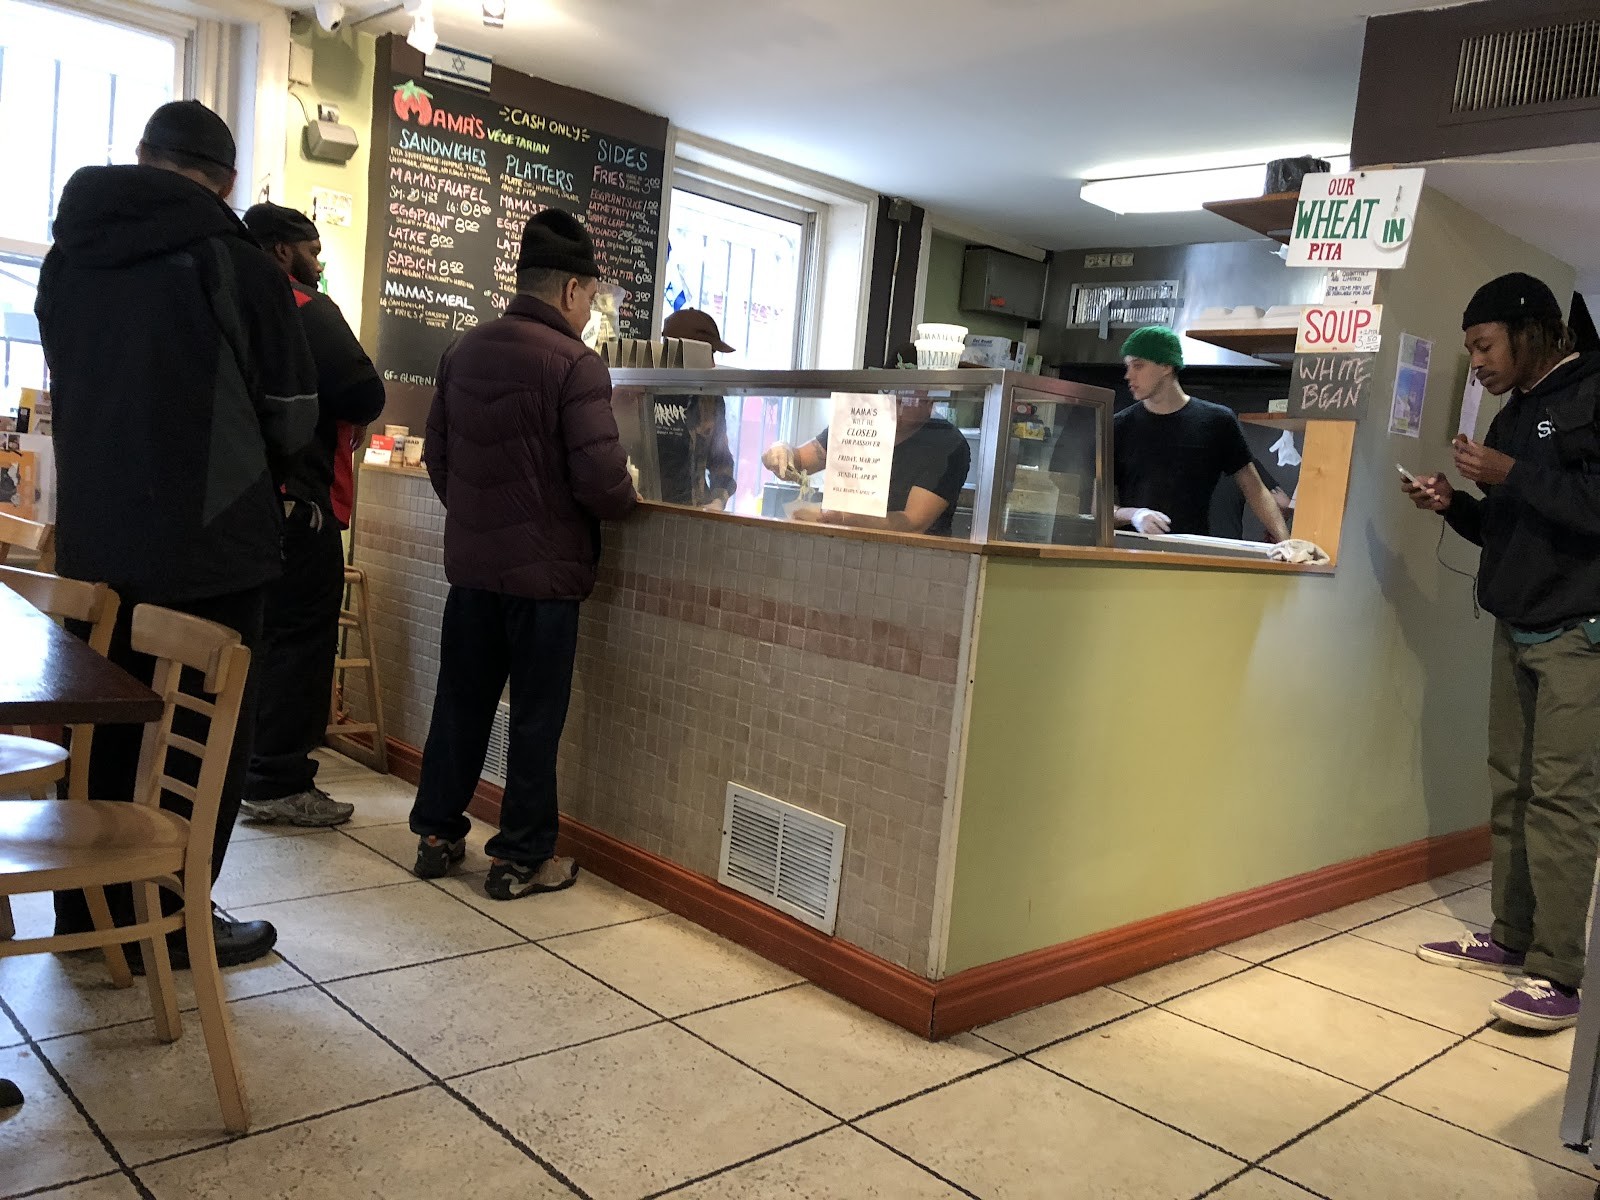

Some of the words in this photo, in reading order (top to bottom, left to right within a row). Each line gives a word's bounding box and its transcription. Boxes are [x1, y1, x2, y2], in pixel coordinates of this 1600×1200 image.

[393, 84, 485, 139] MAMA'S
[511, 109, 546, 131] CASH
[549, 120, 580, 140] ONLY
[400, 128, 487, 167] SANDWICHES
[487, 127, 550, 154] VEGETARIAN
[597, 139, 648, 171] SIDES
[505, 174, 523, 187] PLATE
[506, 154, 574, 193] PLATTERS
[593, 165, 626, 191] FRIES
[390, 167, 437, 190] MAMA'S
[437, 179, 488, 204] FALAFEL
[501, 183, 514, 193] AND
[522, 188, 536, 198] PITA
[1328, 178, 1355, 196] OUR
[500, 194, 538, 215] MAMA'S
[590, 188, 626, 207] EGGPLANT
[626, 197, 643, 209] SLICE
[389, 202, 454, 229] EGGPLANT
[589, 200, 610, 213] LATKE
[611, 207, 630, 221] PATTY
[1295, 198, 1381, 239] WHEAT
[1382, 217, 1406, 244] IN
[587, 223, 618, 239] AVOCADO
[608, 218, 626, 229] LEAF
[389, 225, 427, 245] LATKE
[388, 250, 437, 273] SABICH
[1307, 243, 1343, 260] PITA
[619, 269, 634, 282] PITA
[385, 280, 434, 304] MAMA'S
[435, 294, 475, 311] MEAL
[388, 298, 425, 311] SANDWICH
[1304, 309, 1371, 344] SOUP
[400, 372, 433, 387] GLUTEN
[1300, 356, 1371, 384] WHITE
[1301, 383, 1362, 411] BEAN
[850, 407, 878, 417] MAMA'S
[841, 438, 852, 446] FOR
[852, 440, 881, 448] PASSOVER
[846, 428, 878, 438] CLOSED
[837, 454, 858, 463] FRIDAY,
[837, 471, 859, 480] SUNDAY,
